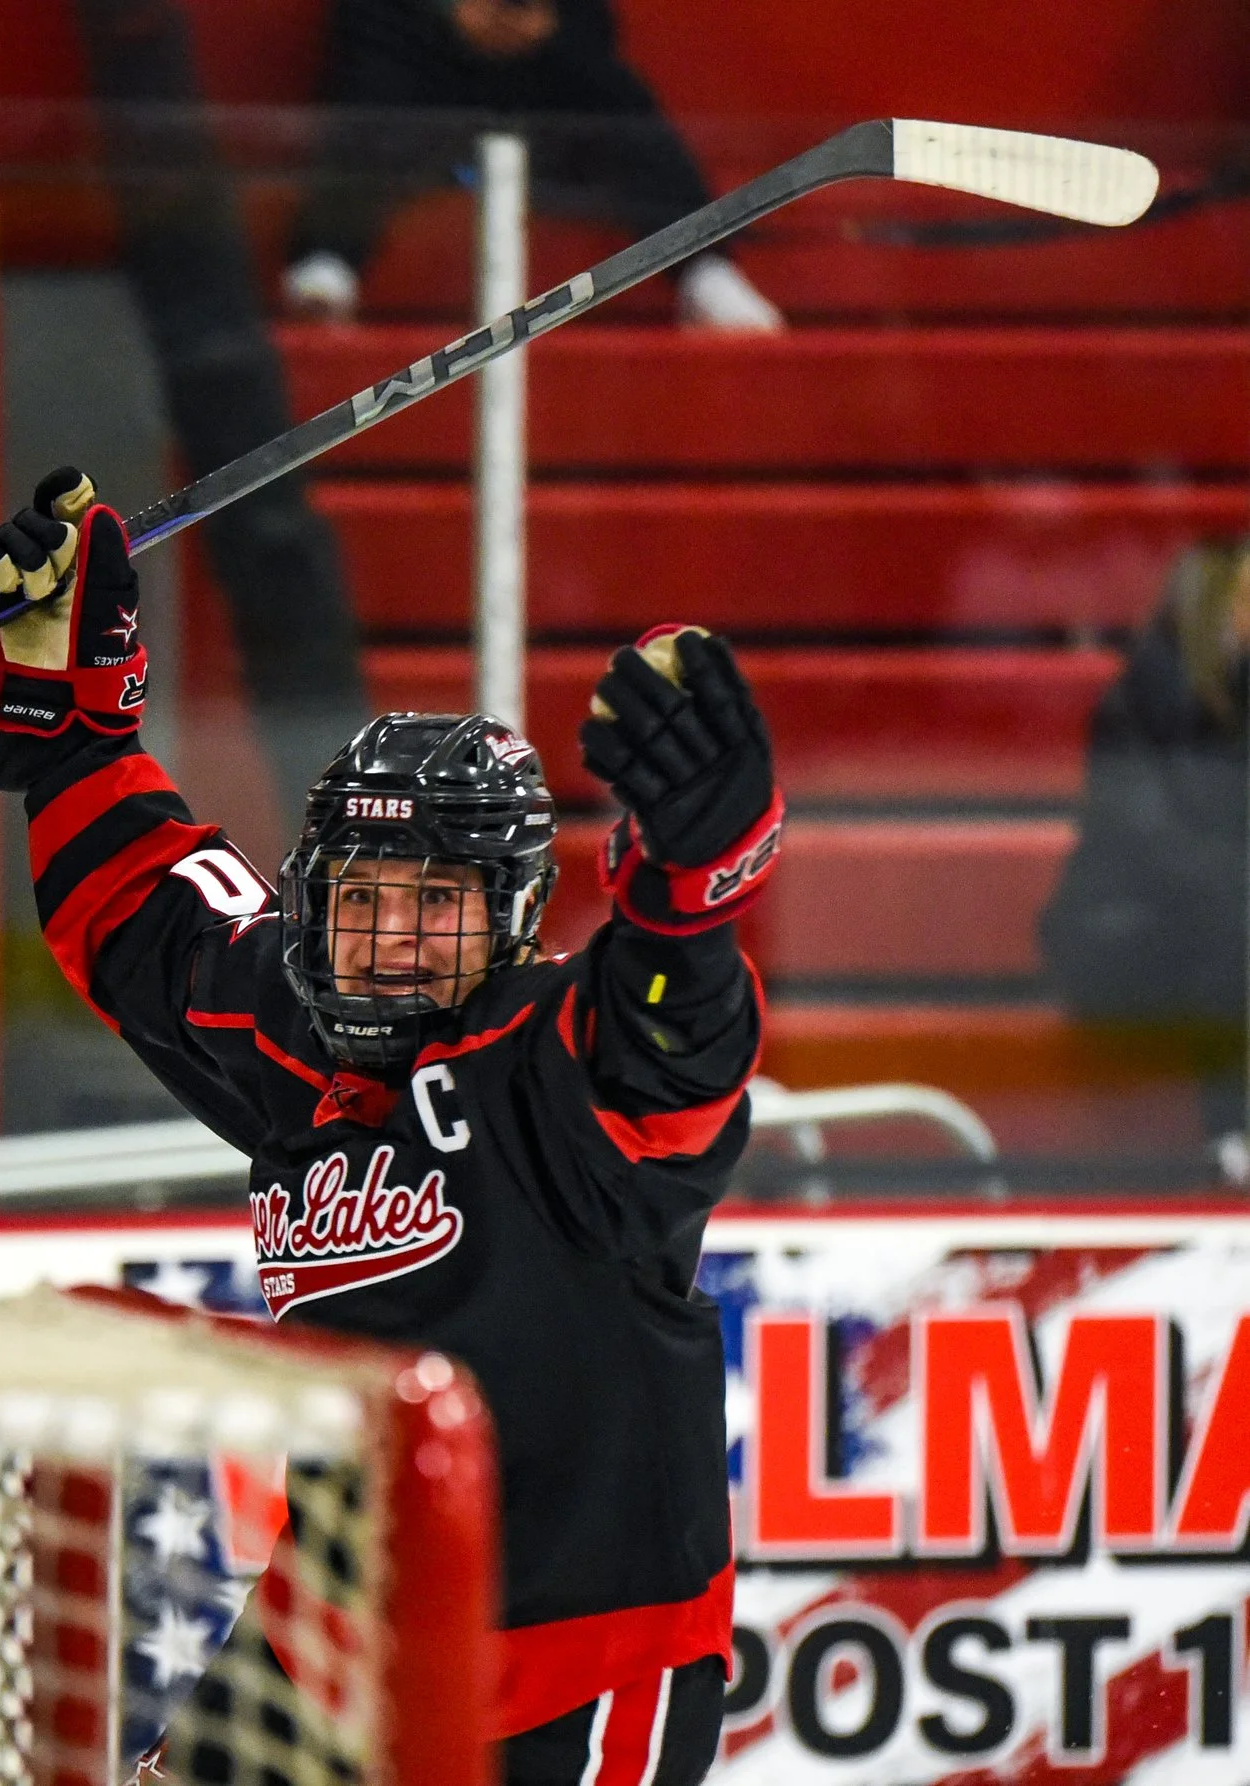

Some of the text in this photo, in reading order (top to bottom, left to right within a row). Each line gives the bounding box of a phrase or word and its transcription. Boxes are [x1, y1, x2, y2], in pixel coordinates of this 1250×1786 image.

[351, 271, 595, 427] CCM
[94, 655, 124, 666] LAKES
[347, 798, 414, 820] STARS
[411, 1063, 471, 1153] C
[288, 1145, 447, 1257] Lakes
[263, 1272, 296, 1299] STARS
